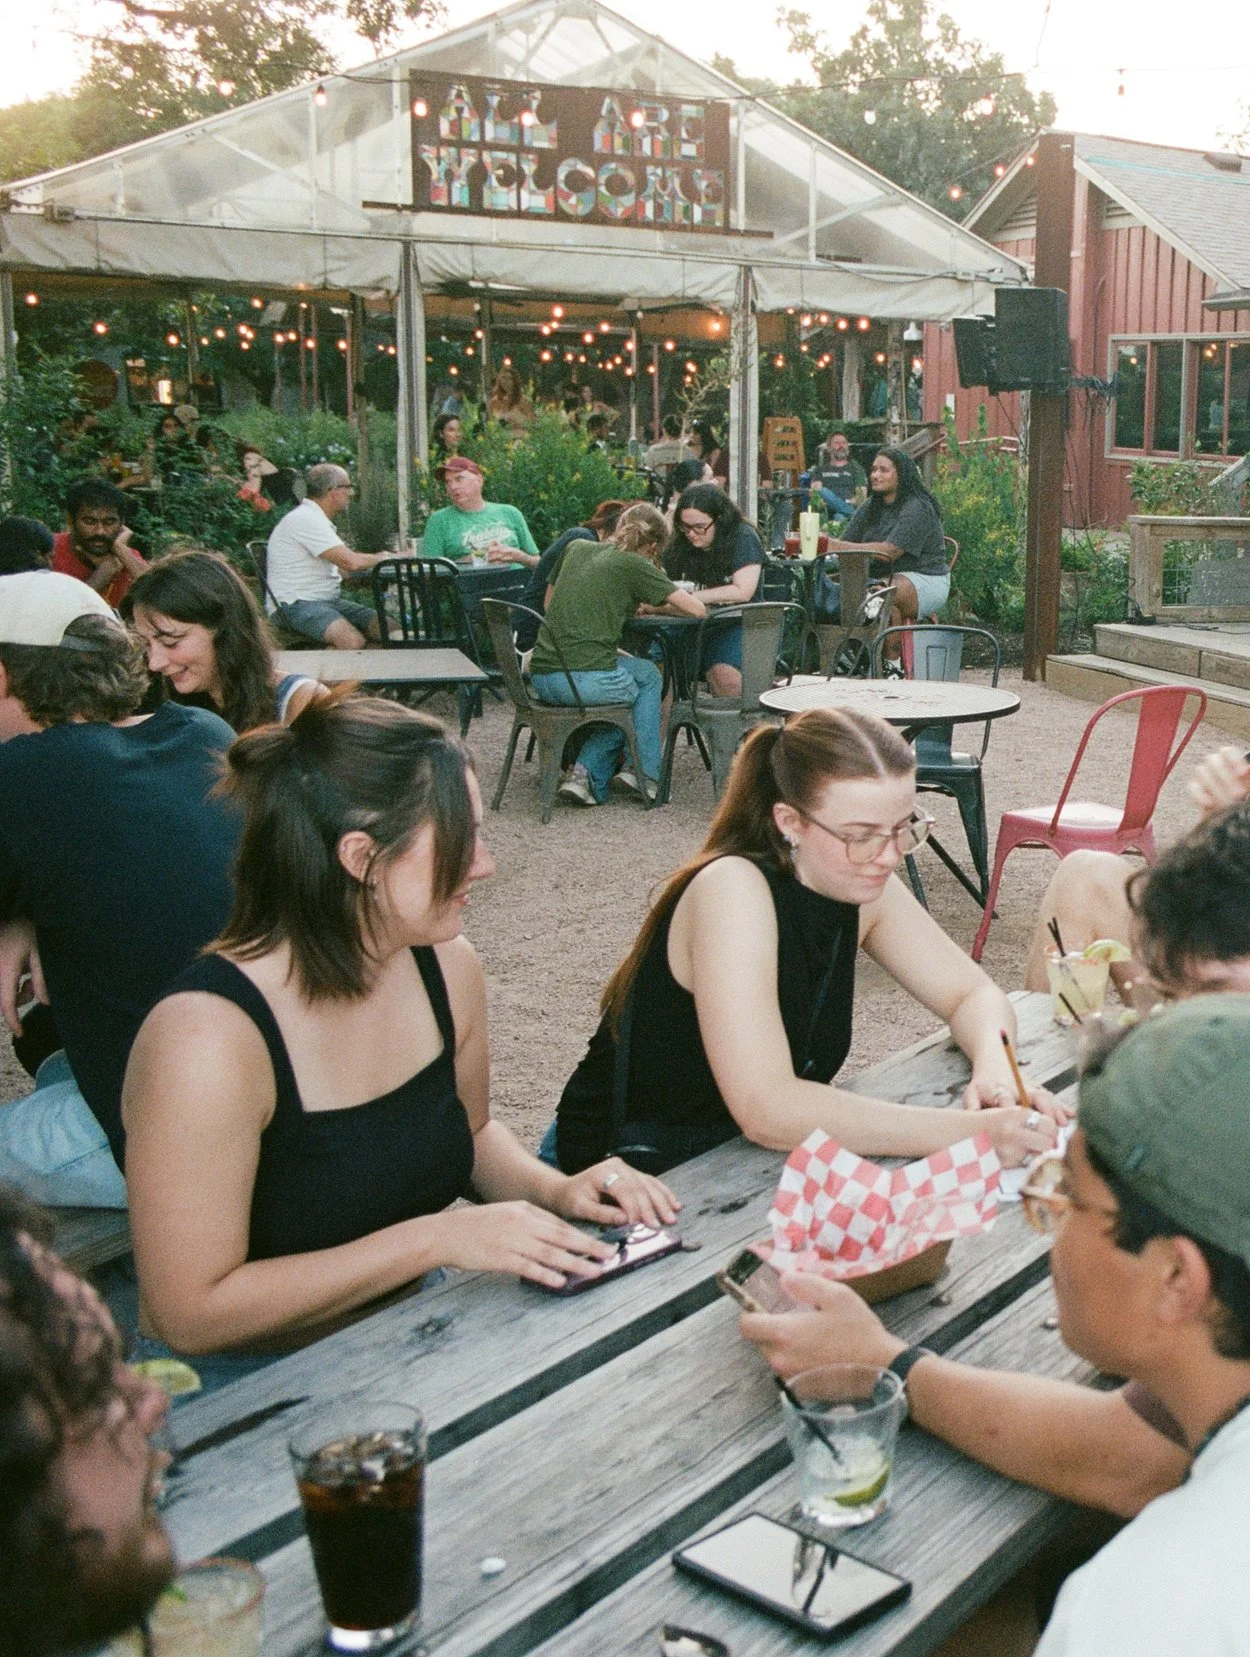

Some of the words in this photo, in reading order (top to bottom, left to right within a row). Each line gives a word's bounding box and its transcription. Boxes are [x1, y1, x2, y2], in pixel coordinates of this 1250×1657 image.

[439, 82, 558, 149] ALL
[593, 96, 705, 160] ARE
[418, 144, 725, 226] WELCOME
